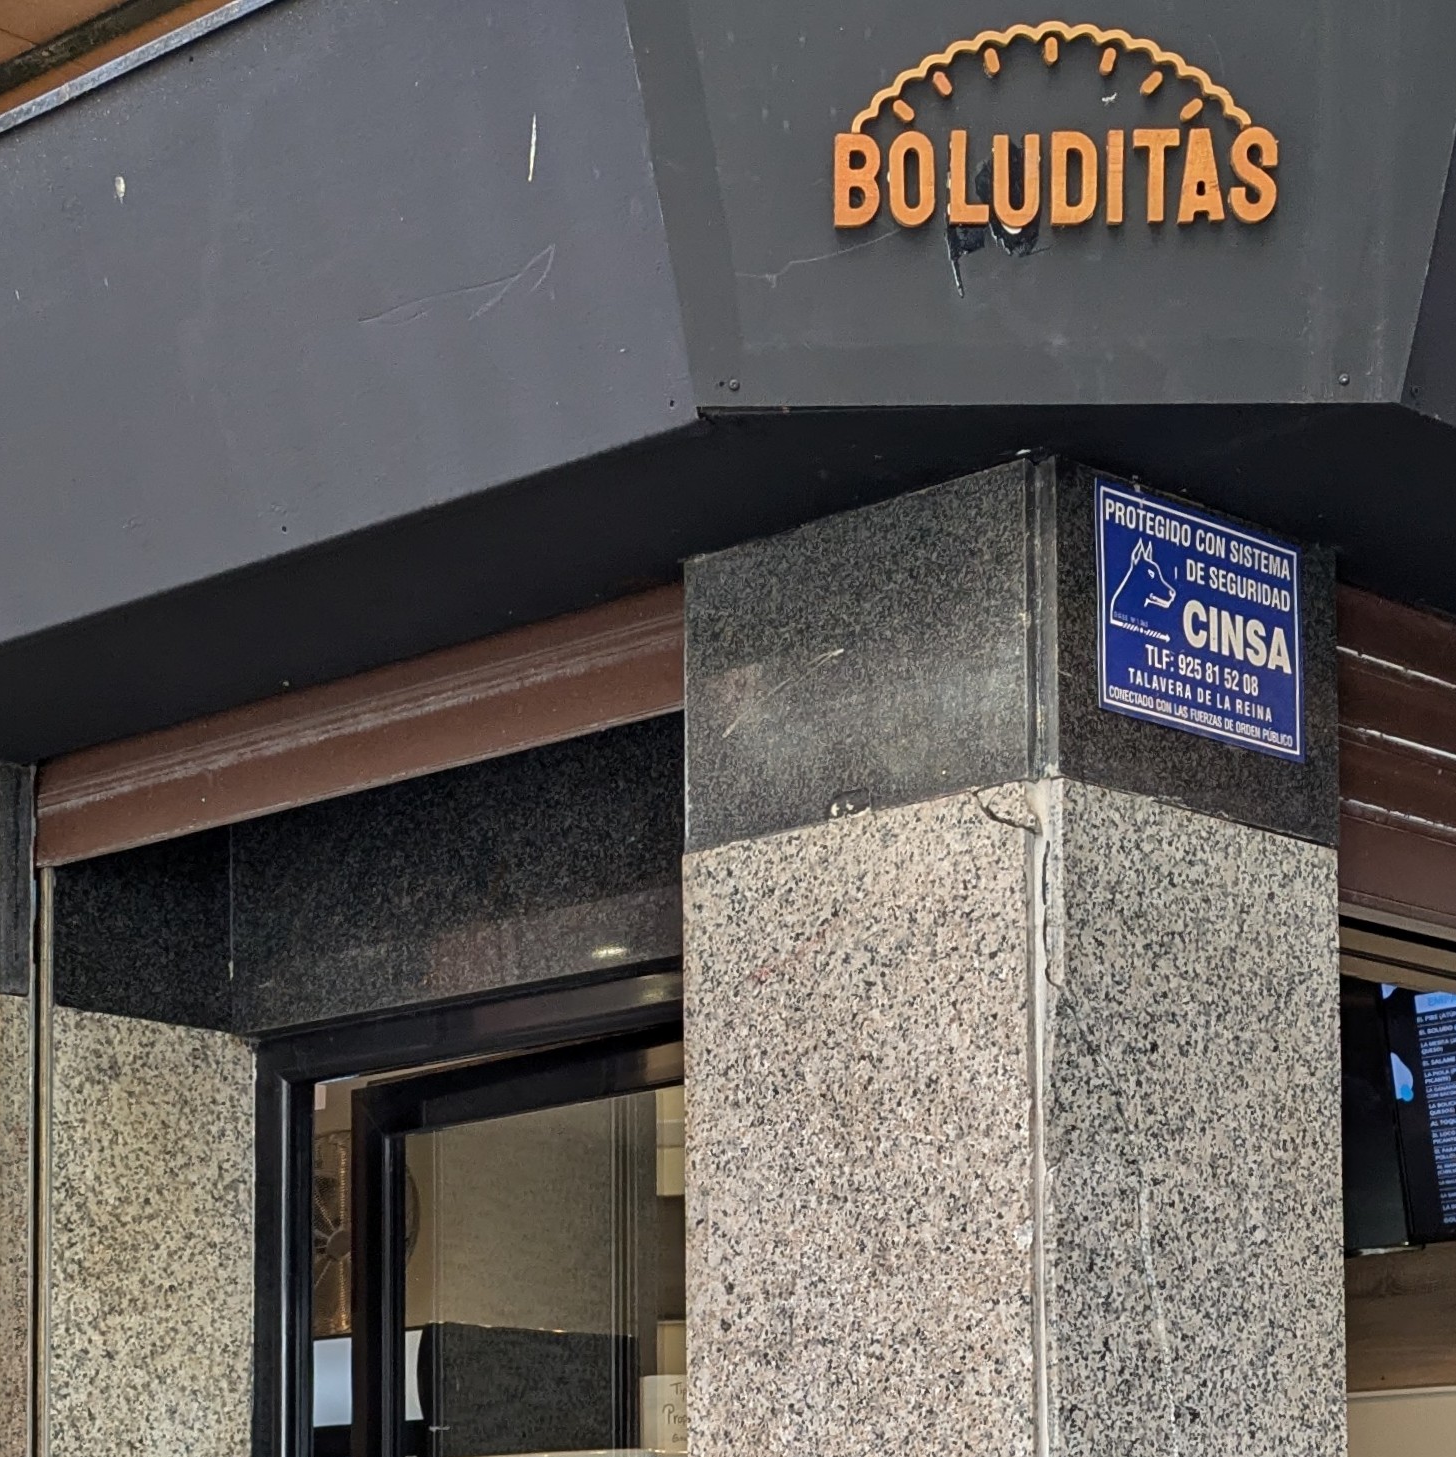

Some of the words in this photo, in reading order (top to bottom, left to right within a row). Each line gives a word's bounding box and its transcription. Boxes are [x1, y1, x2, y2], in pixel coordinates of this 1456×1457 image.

[834, 126, 1279, 229] BOLUDITAS
[1105, 498, 1191, 547] PROTEGIDO
[1196, 529, 1226, 556] CON
[1230, 540, 1291, 581] SISTEMA
[1186, 558, 1205, 585] DE
[1209, 566, 1291, 613] SEGURIDAD
[1183, 600, 1292, 674] CINSA
[1128, 667, 1192, 700] TALAVERA
[1197, 687, 1212, 706] DE
[1216, 692, 1231, 711] LA
[1235, 696, 1272, 723] REINA
[1145, 643, 1174, 672] TLF:
[1178, 654, 1202, 680] 925
[1205, 664, 1219, 685] 81
[1224, 669, 1239, 691] 52
[1243, 673, 1259, 697] 08
[1109, 685, 1154, 709] CONECTADO
[1156, 697, 1172, 714] CON
[1174, 703, 1189, 719] LAS
[1190, 707, 1223, 728] FUERZAS
[1224, 716, 1234, 732] DE
[1235, 719, 1261, 739] ORDEN
[1262, 725, 1293, 747] PÚBLICO
